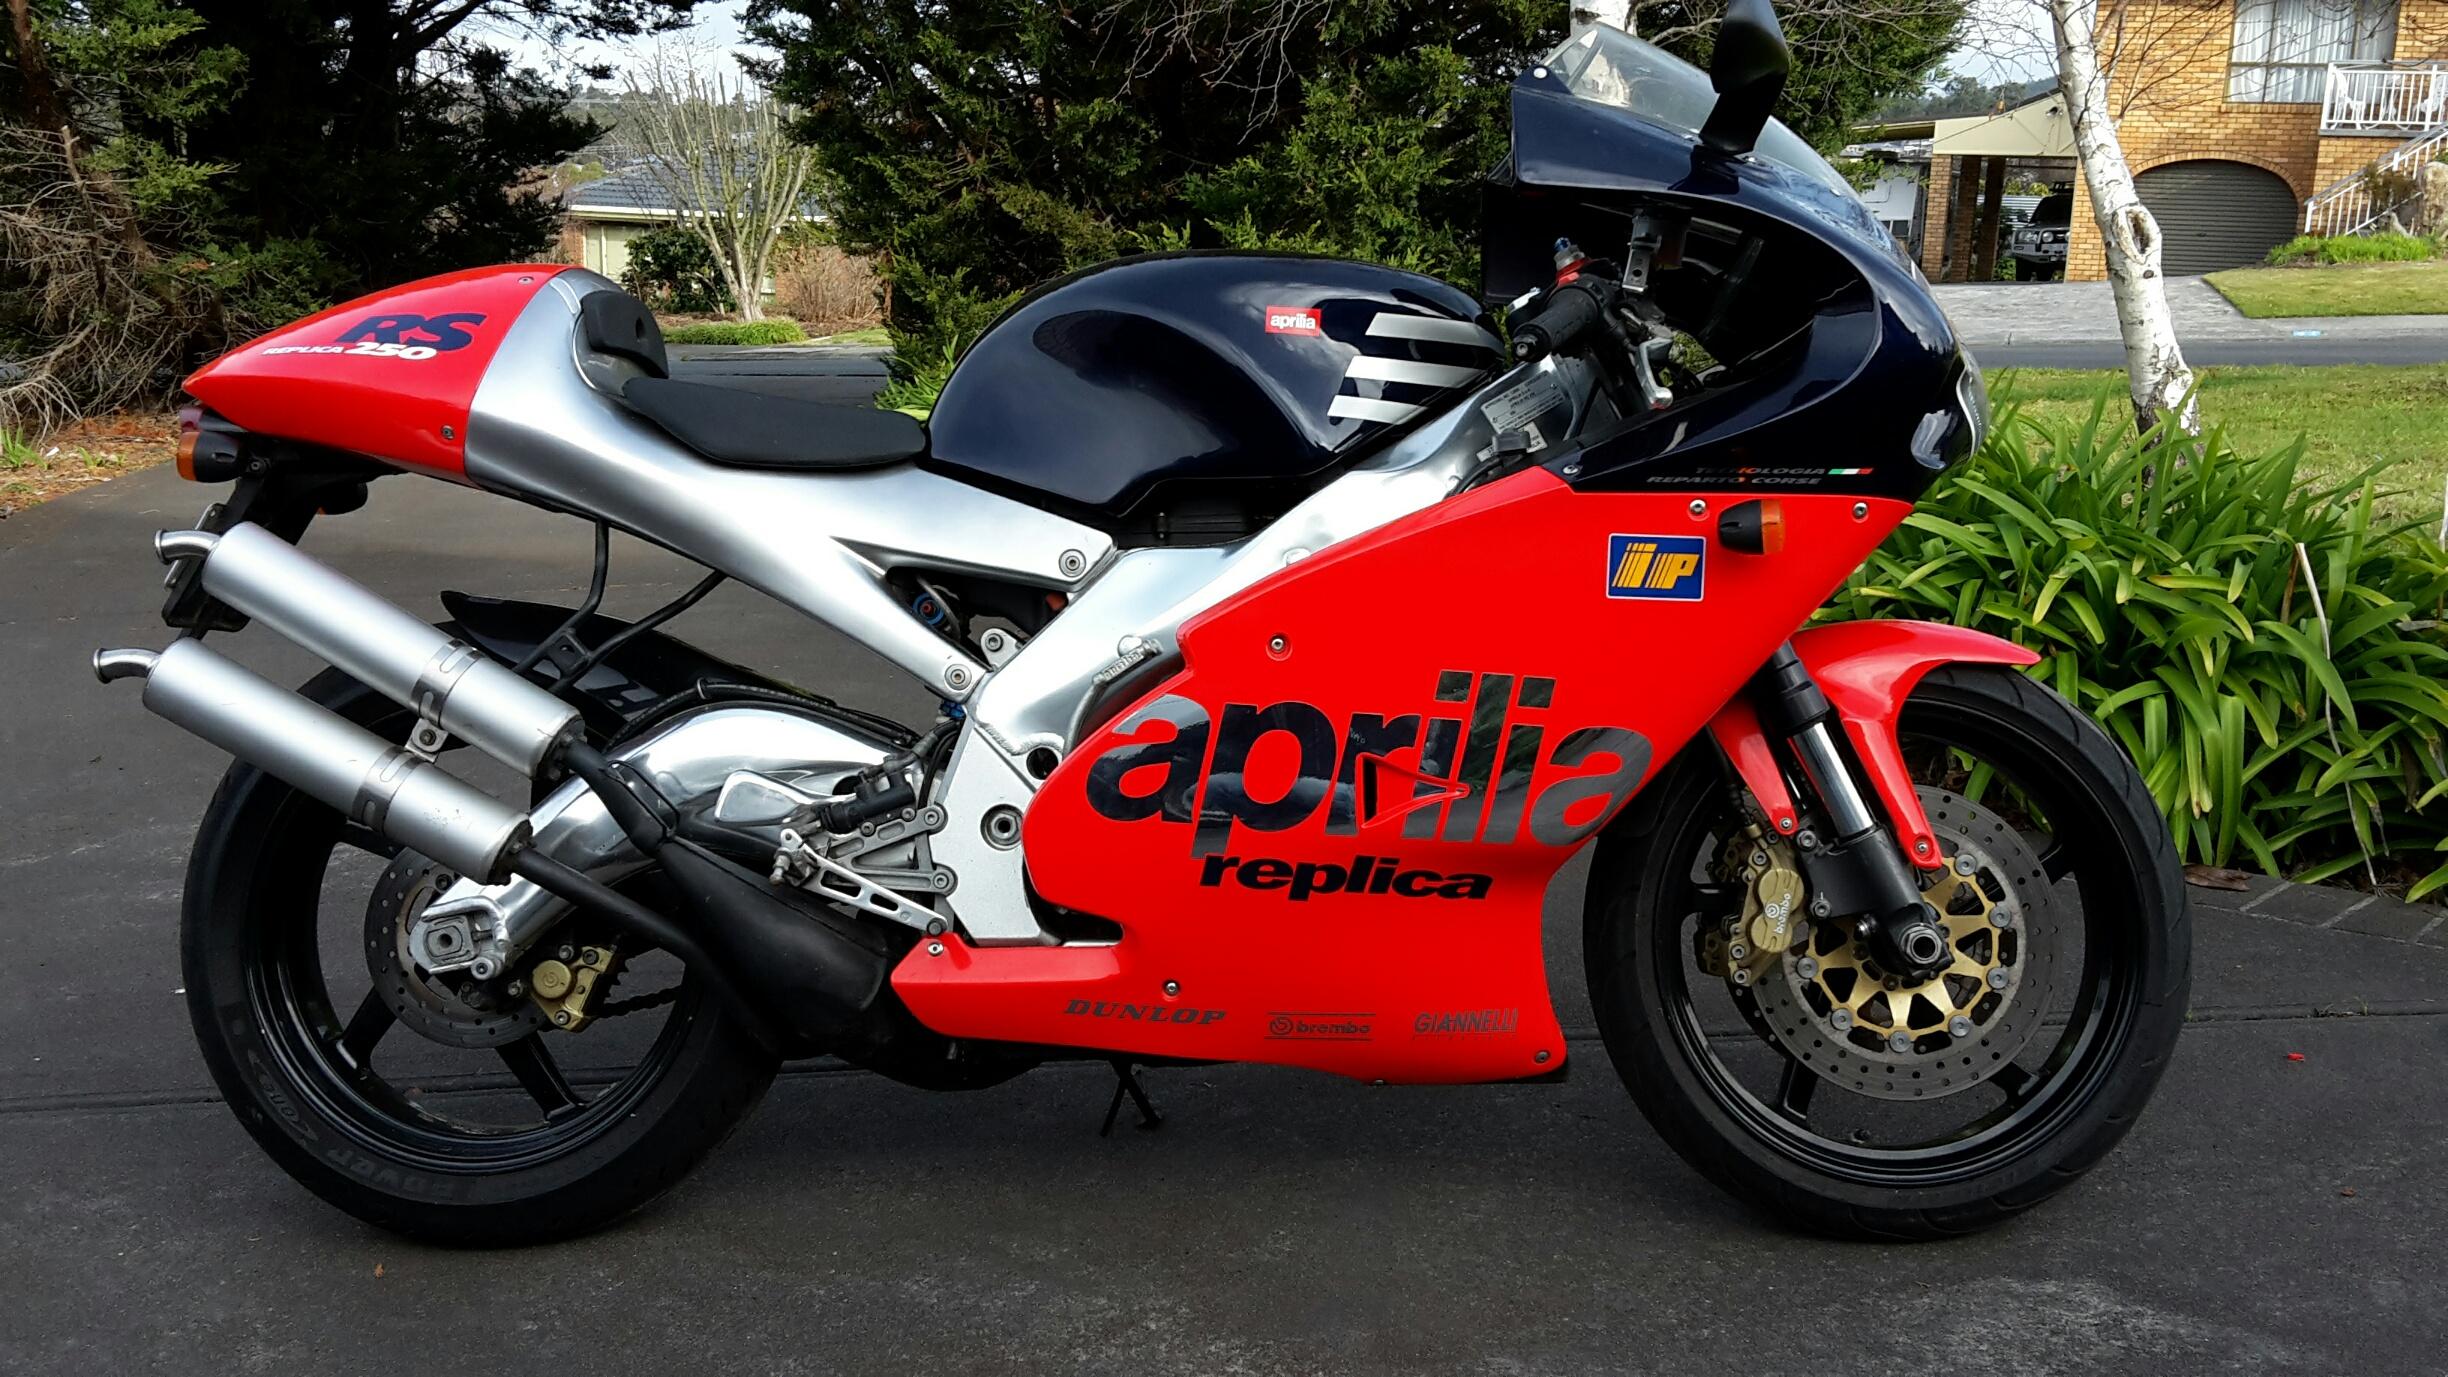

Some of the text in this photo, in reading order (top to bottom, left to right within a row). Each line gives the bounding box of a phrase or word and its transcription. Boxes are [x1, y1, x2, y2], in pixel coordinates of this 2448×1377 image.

[335, 313, 487, 352] RS
[1270, 312, 1317, 330] aprilia
[262, 341, 438, 360] REPLICA 250
[1646, 476, 1823, 485] REPARTO CORSE
[1085, 669, 1655, 859] aprilia
[1200, 854, 1494, 902] replica
[1774, 893, 1791, 934] brembo
[1064, 999, 1228, 1025] DUNLOP
[1414, 1007, 1519, 1034] GIANNELLI
[1295, 1020, 1371, 1035] brembo
